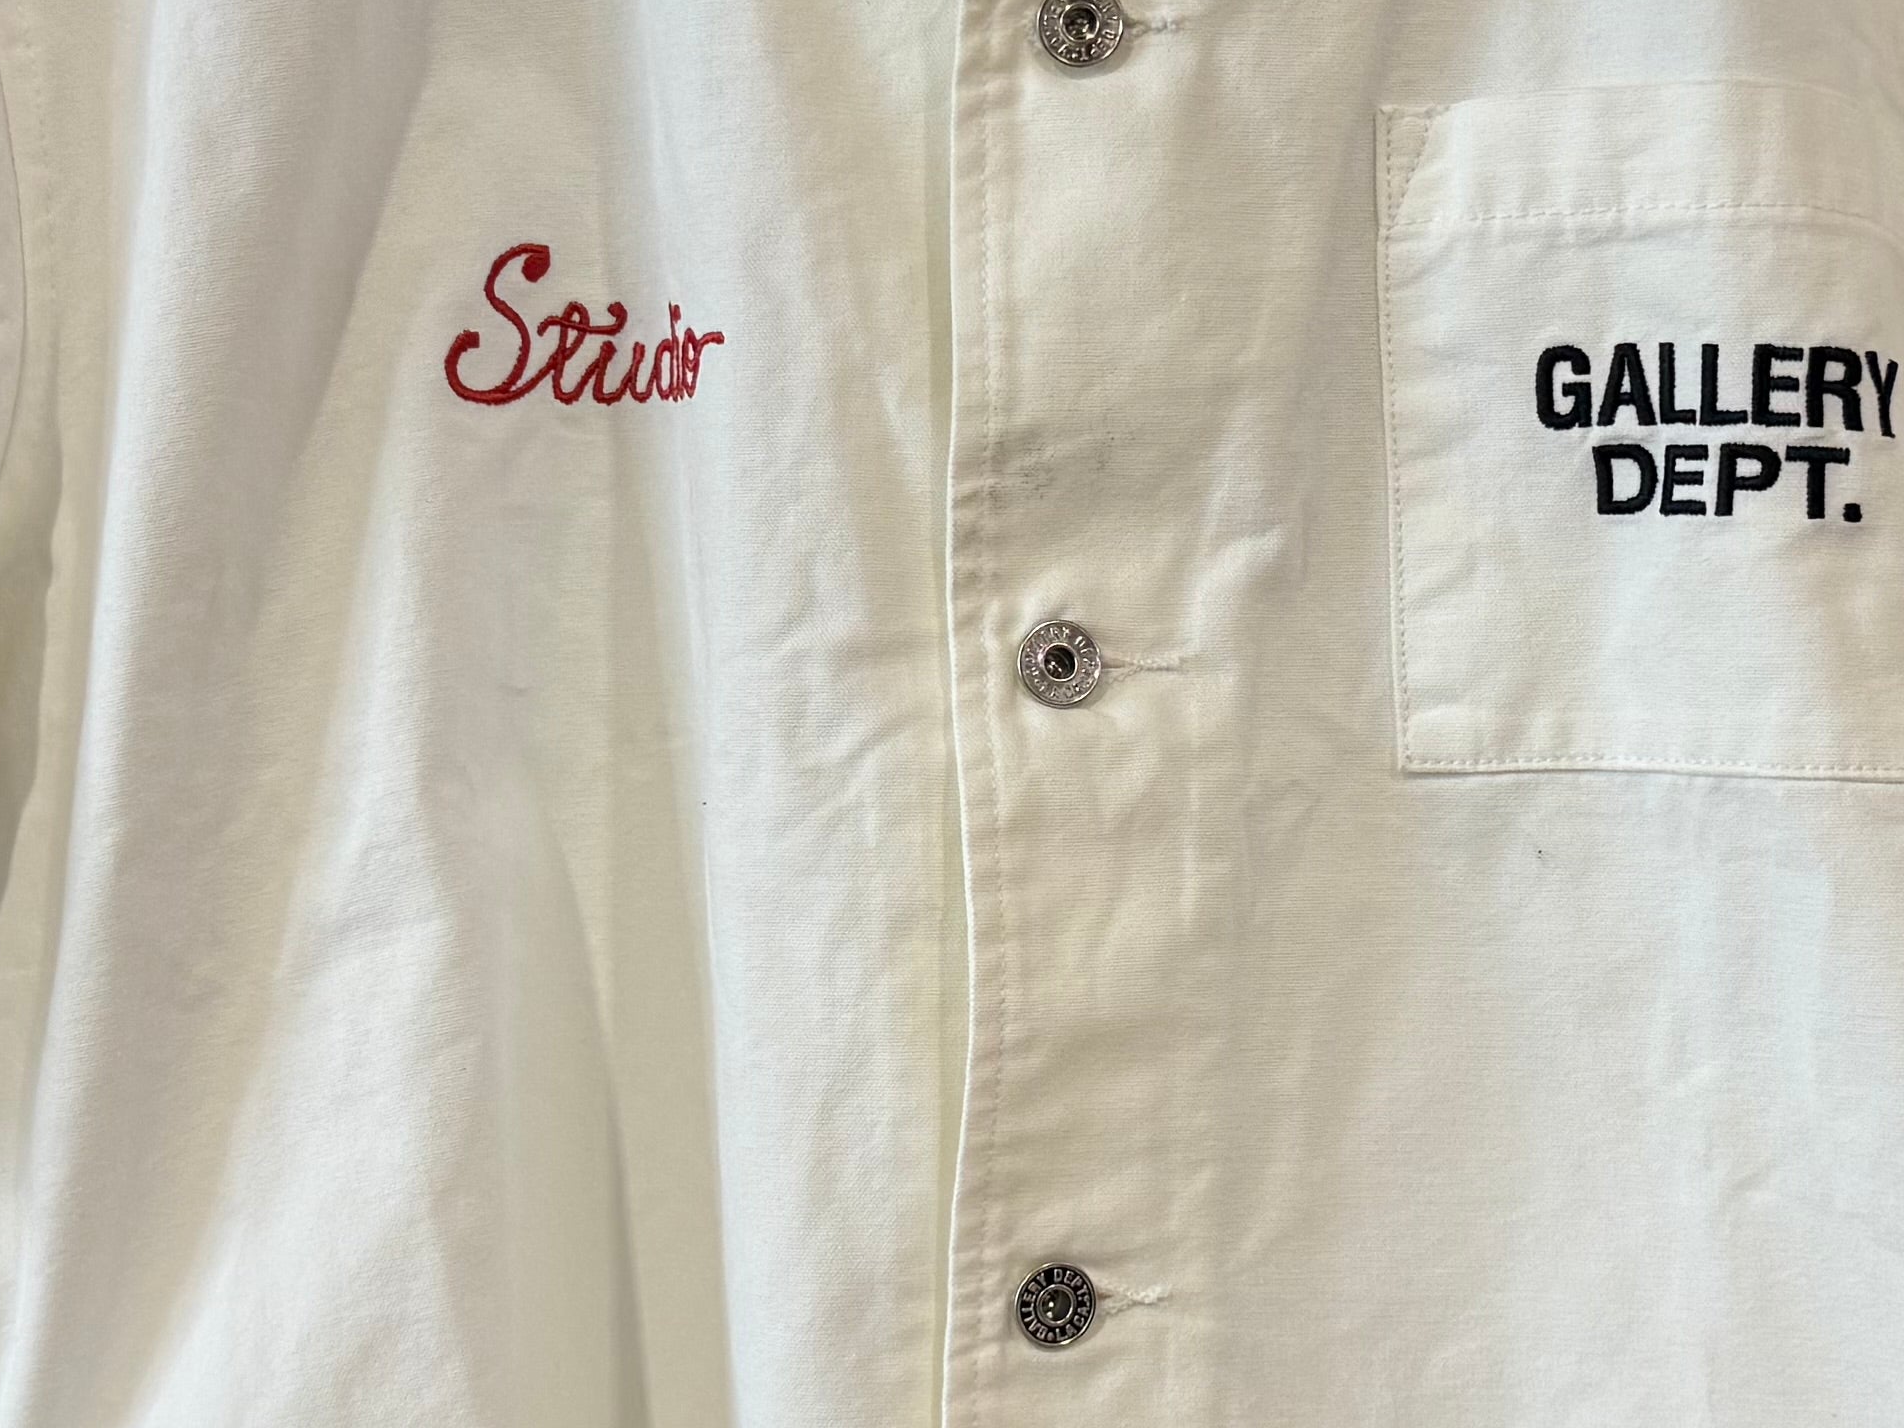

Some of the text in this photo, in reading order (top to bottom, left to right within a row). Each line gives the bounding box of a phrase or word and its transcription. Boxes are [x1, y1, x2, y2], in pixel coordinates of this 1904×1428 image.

[443, 242, 725, 406] Studio
[1534, 341, 1899, 438] GALLERY
[1592, 443, 1863, 523] DEPT.
